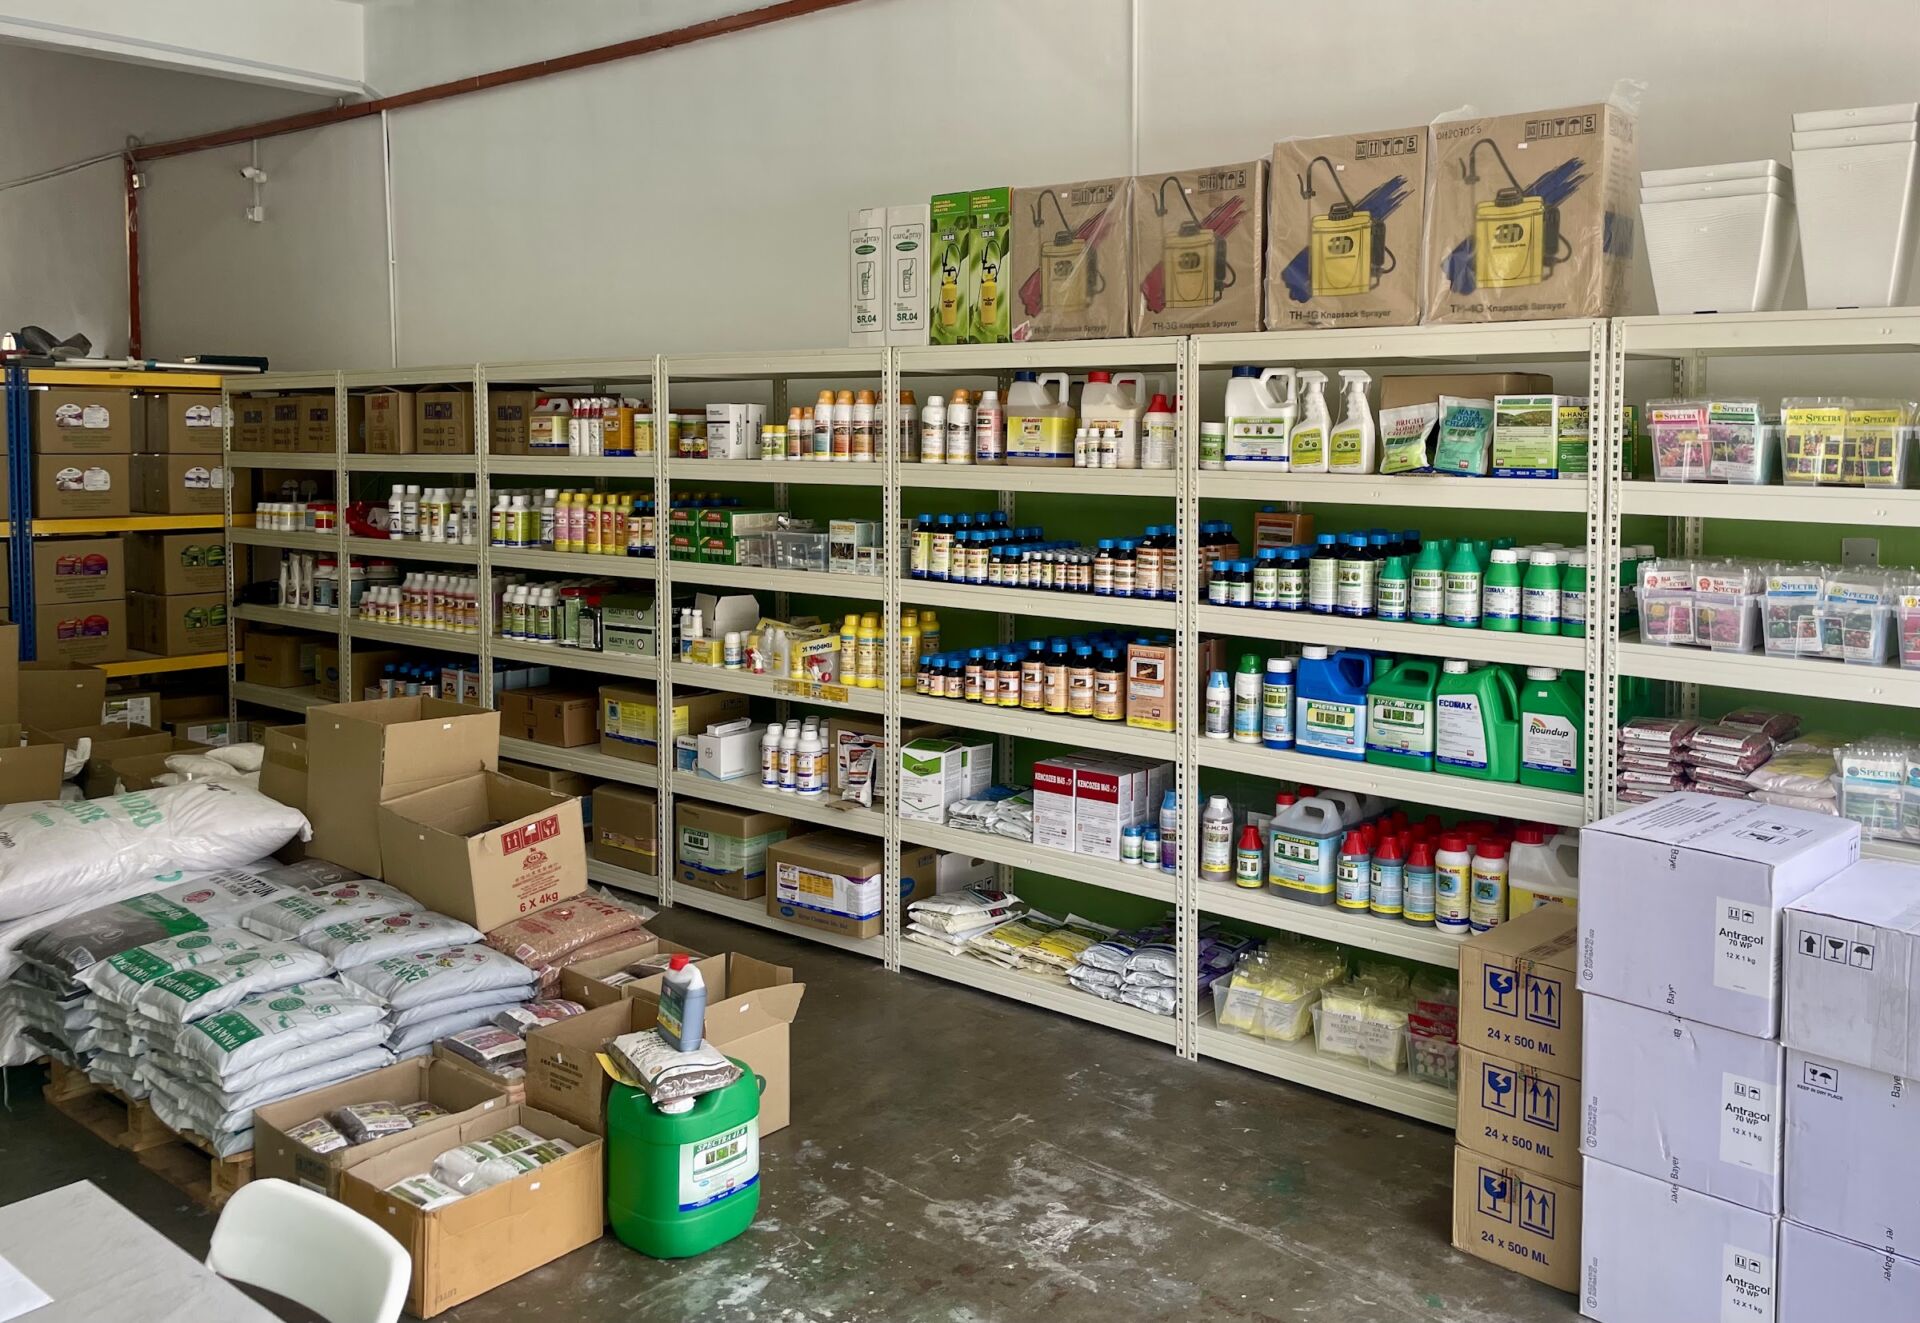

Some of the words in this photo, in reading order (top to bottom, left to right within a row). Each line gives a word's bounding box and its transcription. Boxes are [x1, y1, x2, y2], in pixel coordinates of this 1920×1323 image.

[856, 314, 876, 324] SR.04
[896, 312, 918, 322] SR.04
[1721, 404, 1754, 413] SPECTRA
[1664, 411, 1698, 421] SPECTRA
[1806, 413, 1841, 423] SPECTRA
[1863, 414, 1896, 424] SPECTRA
[1781, 582, 1818, 592] SPECTRA
[1842, 588, 1880, 600] SPECTRA
[1529, 724, 1569, 738] Roundup
[1860, 768, 1901, 778] SPECTRA
[520, 902, 527, 913] 6
[529, 898, 536, 909] X
[539, 891, 560, 906] 4kg
[1719, 926, 1764, 946] Antracol
[1728, 938, 1738, 948] 70
[1739, 940, 1753, 950] WP
[1747, 957, 1756, 966] kg
[1487, 1026, 1500, 1040] 24
[1514, 1034, 1534, 1050] 500
[1538, 1042, 1556, 1056] ML
[1828, 1092, 1843, 1101] PLACE
[1725, 1102, 1770, 1123] Antracol
[1735, 1114, 1745, 1123] 70
[1746, 1116, 1759, 1126] WP
[1484, 1126, 1498, 1140] 24
[1512, 1134, 1532, 1150] 500
[1536, 1144, 1554, 1158] ML
[1754, 1132, 1762, 1142] kg
[1670, 1156, 1680, 1180] Bayer
[1481, 1230, 1494, 1244] 24
[1508, 1240, 1529, 1257] 500
[1532, 1250, 1550, 1266] ML
[1883, 1255, 1896, 1282] Bayer
[1726, 1274, 1770, 1295] Antracol
[1736, 1286, 1745, 1295] 70
[1746, 1288, 1760, 1298] WP
[1754, 1305, 1762, 1314] kg
